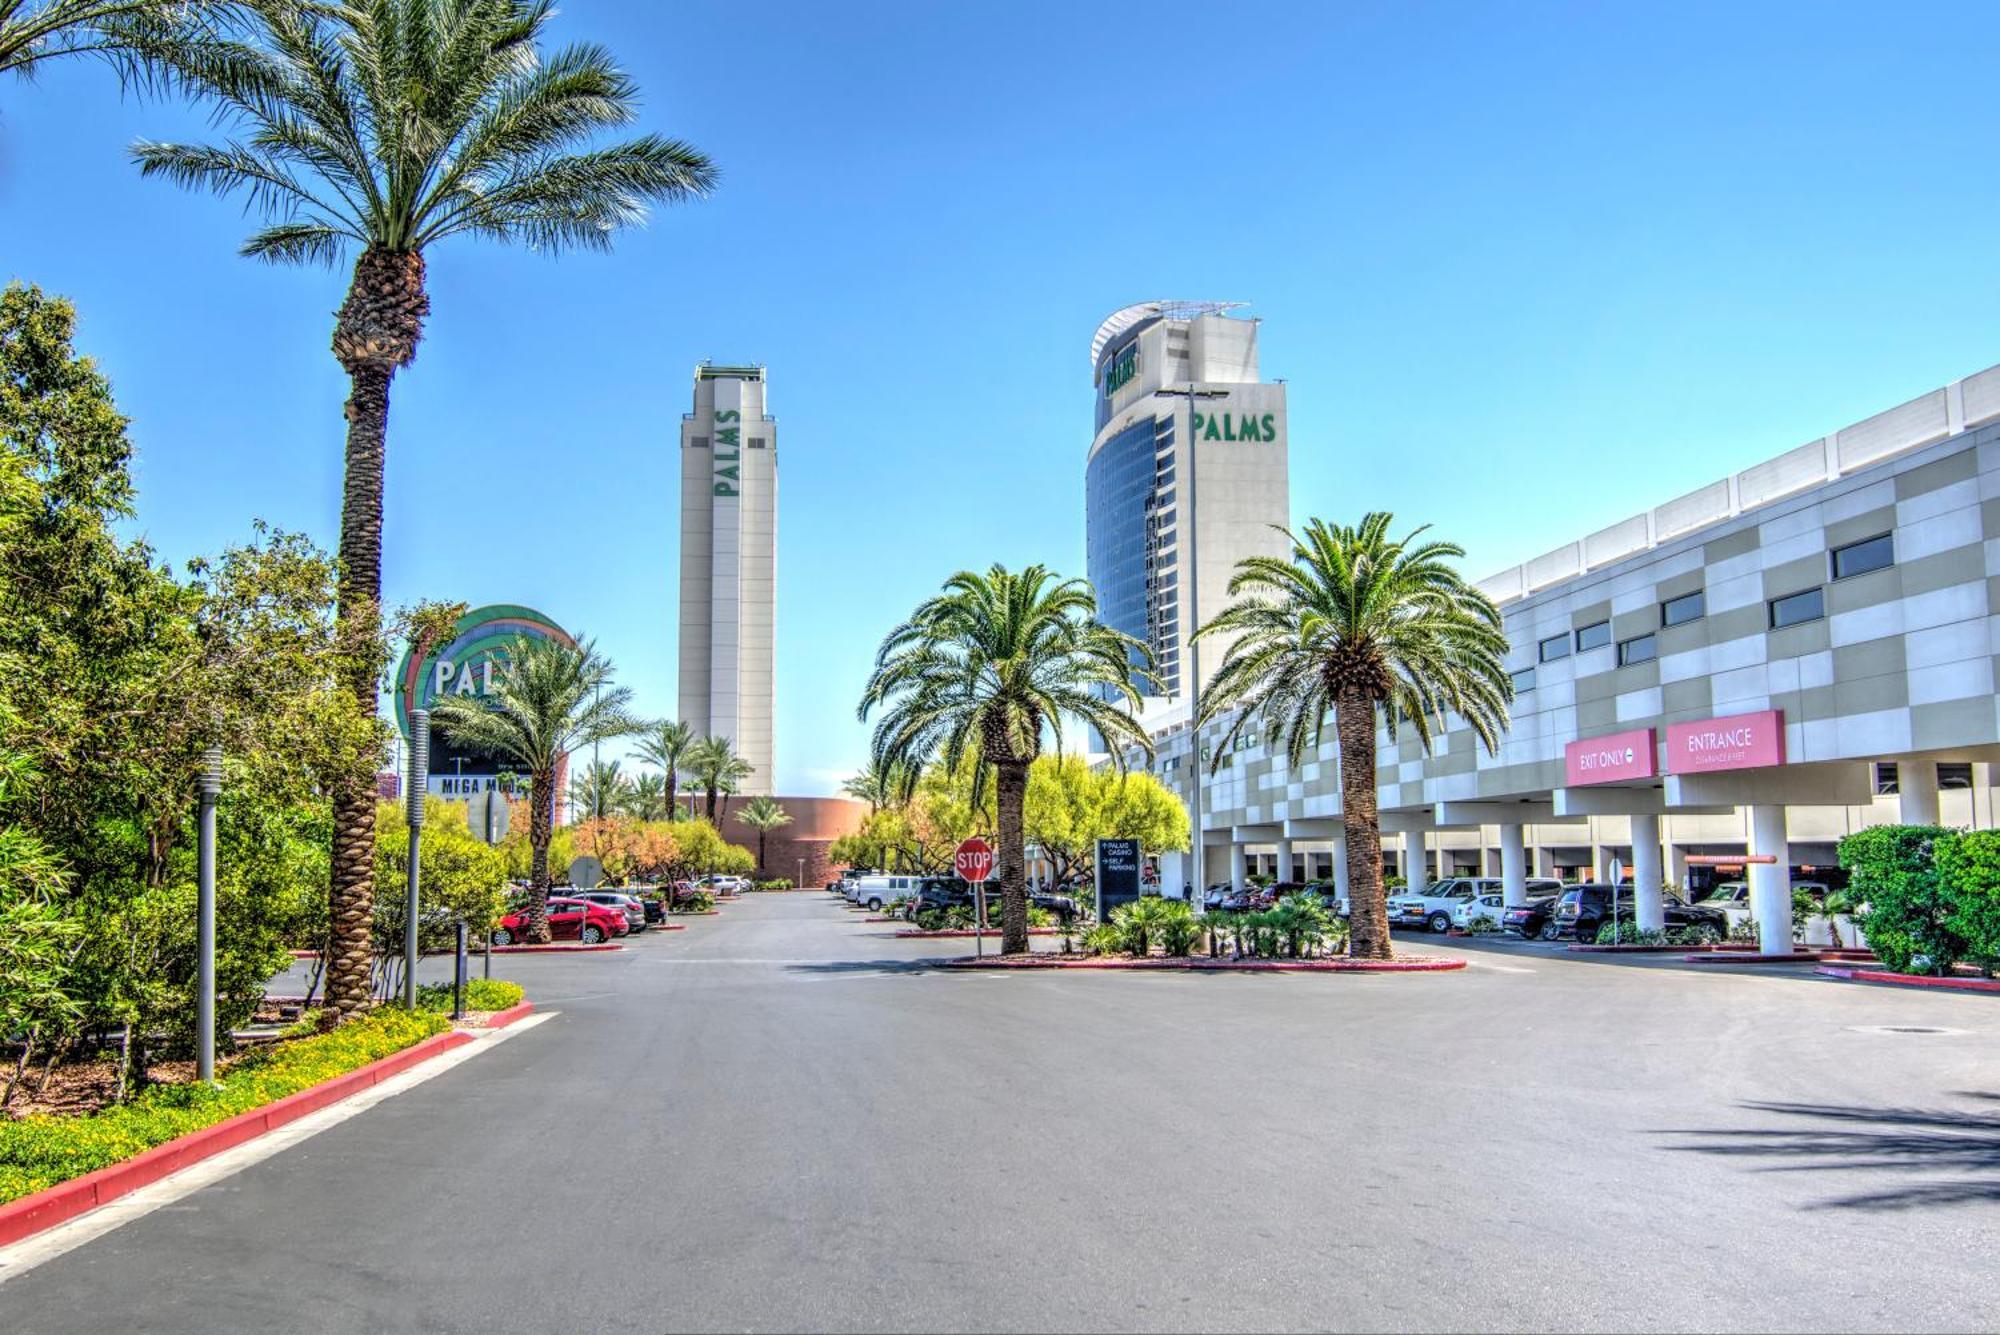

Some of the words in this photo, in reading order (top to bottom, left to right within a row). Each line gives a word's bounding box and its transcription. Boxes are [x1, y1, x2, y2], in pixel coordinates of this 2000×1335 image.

[714, 410, 740, 496] PALMS
[436, 660, 514, 695] PAL
[1688, 728, 1752, 752] ENTRANCE
[1580, 753, 1597, 770] EXIT
[1600, 749, 1624, 768] ONLY
[957, 851, 991, 869] STOP
